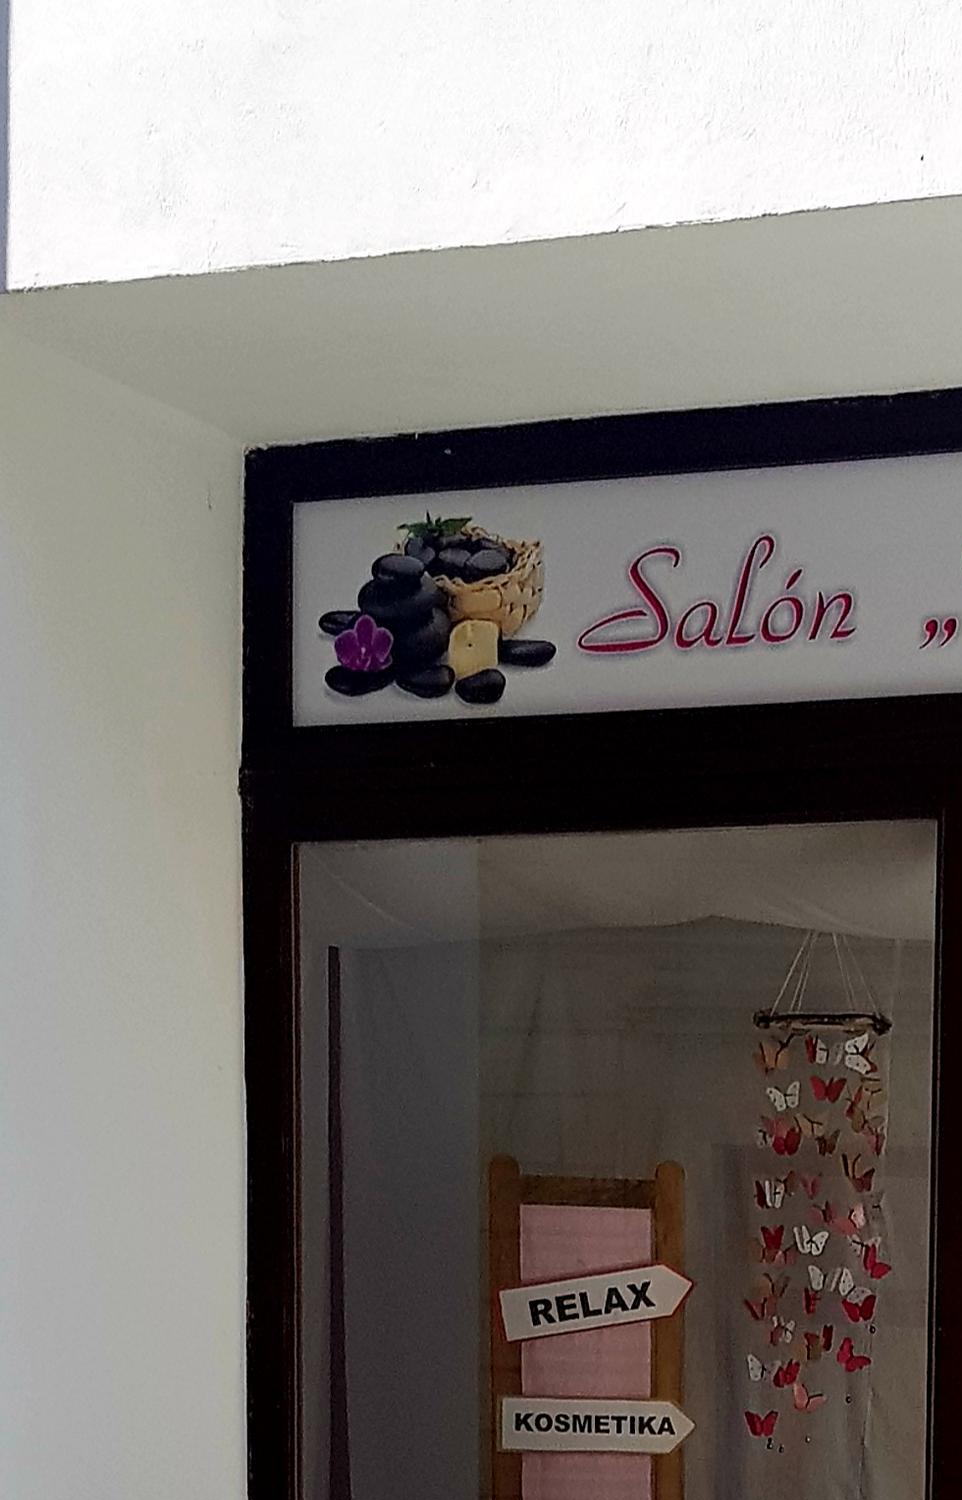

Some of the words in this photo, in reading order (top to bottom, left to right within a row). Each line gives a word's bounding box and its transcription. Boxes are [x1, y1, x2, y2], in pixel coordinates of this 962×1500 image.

[577, 534, 857, 653] Salón
[528, 1280, 656, 1327] RELAX
[513, 1412, 676, 1436] KOSMETIKA
